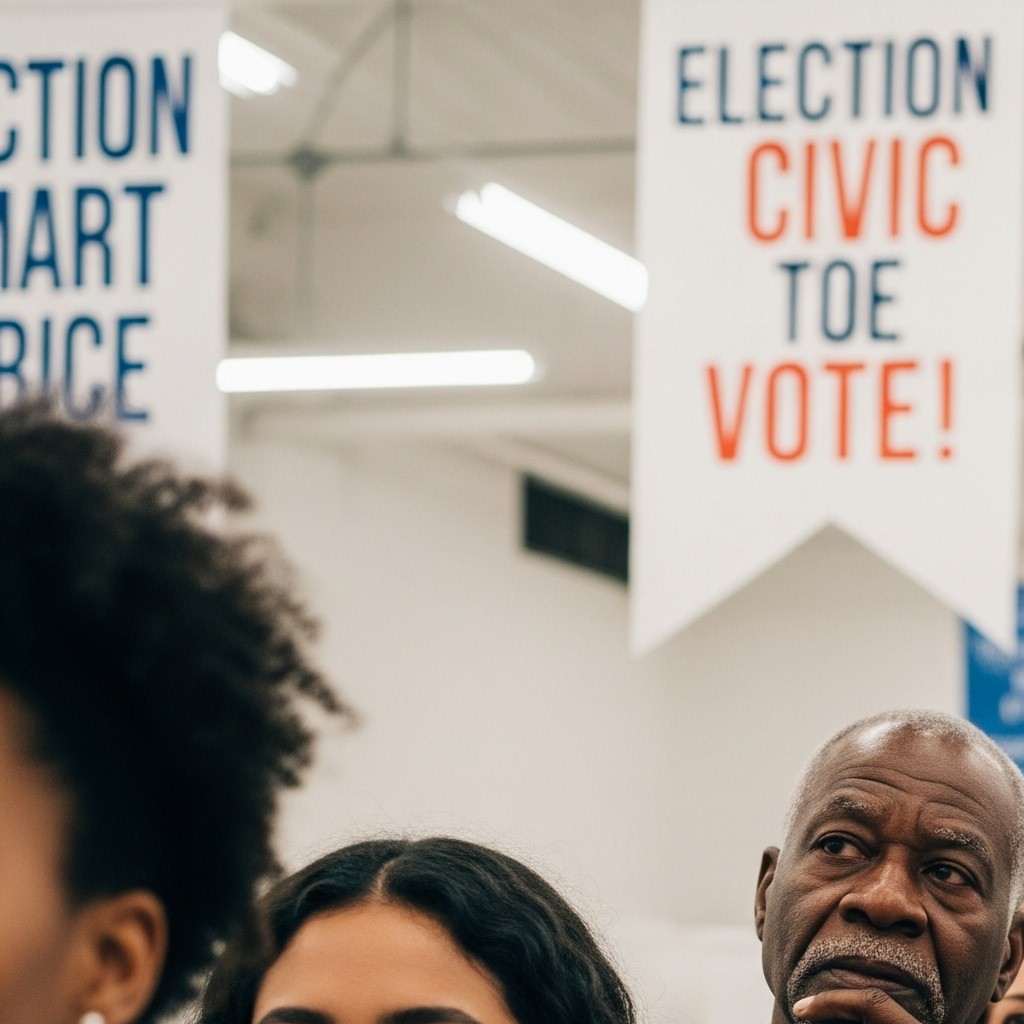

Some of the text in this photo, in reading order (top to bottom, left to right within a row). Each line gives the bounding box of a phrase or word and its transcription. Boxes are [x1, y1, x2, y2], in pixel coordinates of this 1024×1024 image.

[676, 36, 992, 124] ELECTION
[0, 185, 164, 289] ART
[746, 135, 961, 243] CIVIC
[778, 258, 902, 343] TOE
[706, 358, 956, 463] VOTE!
